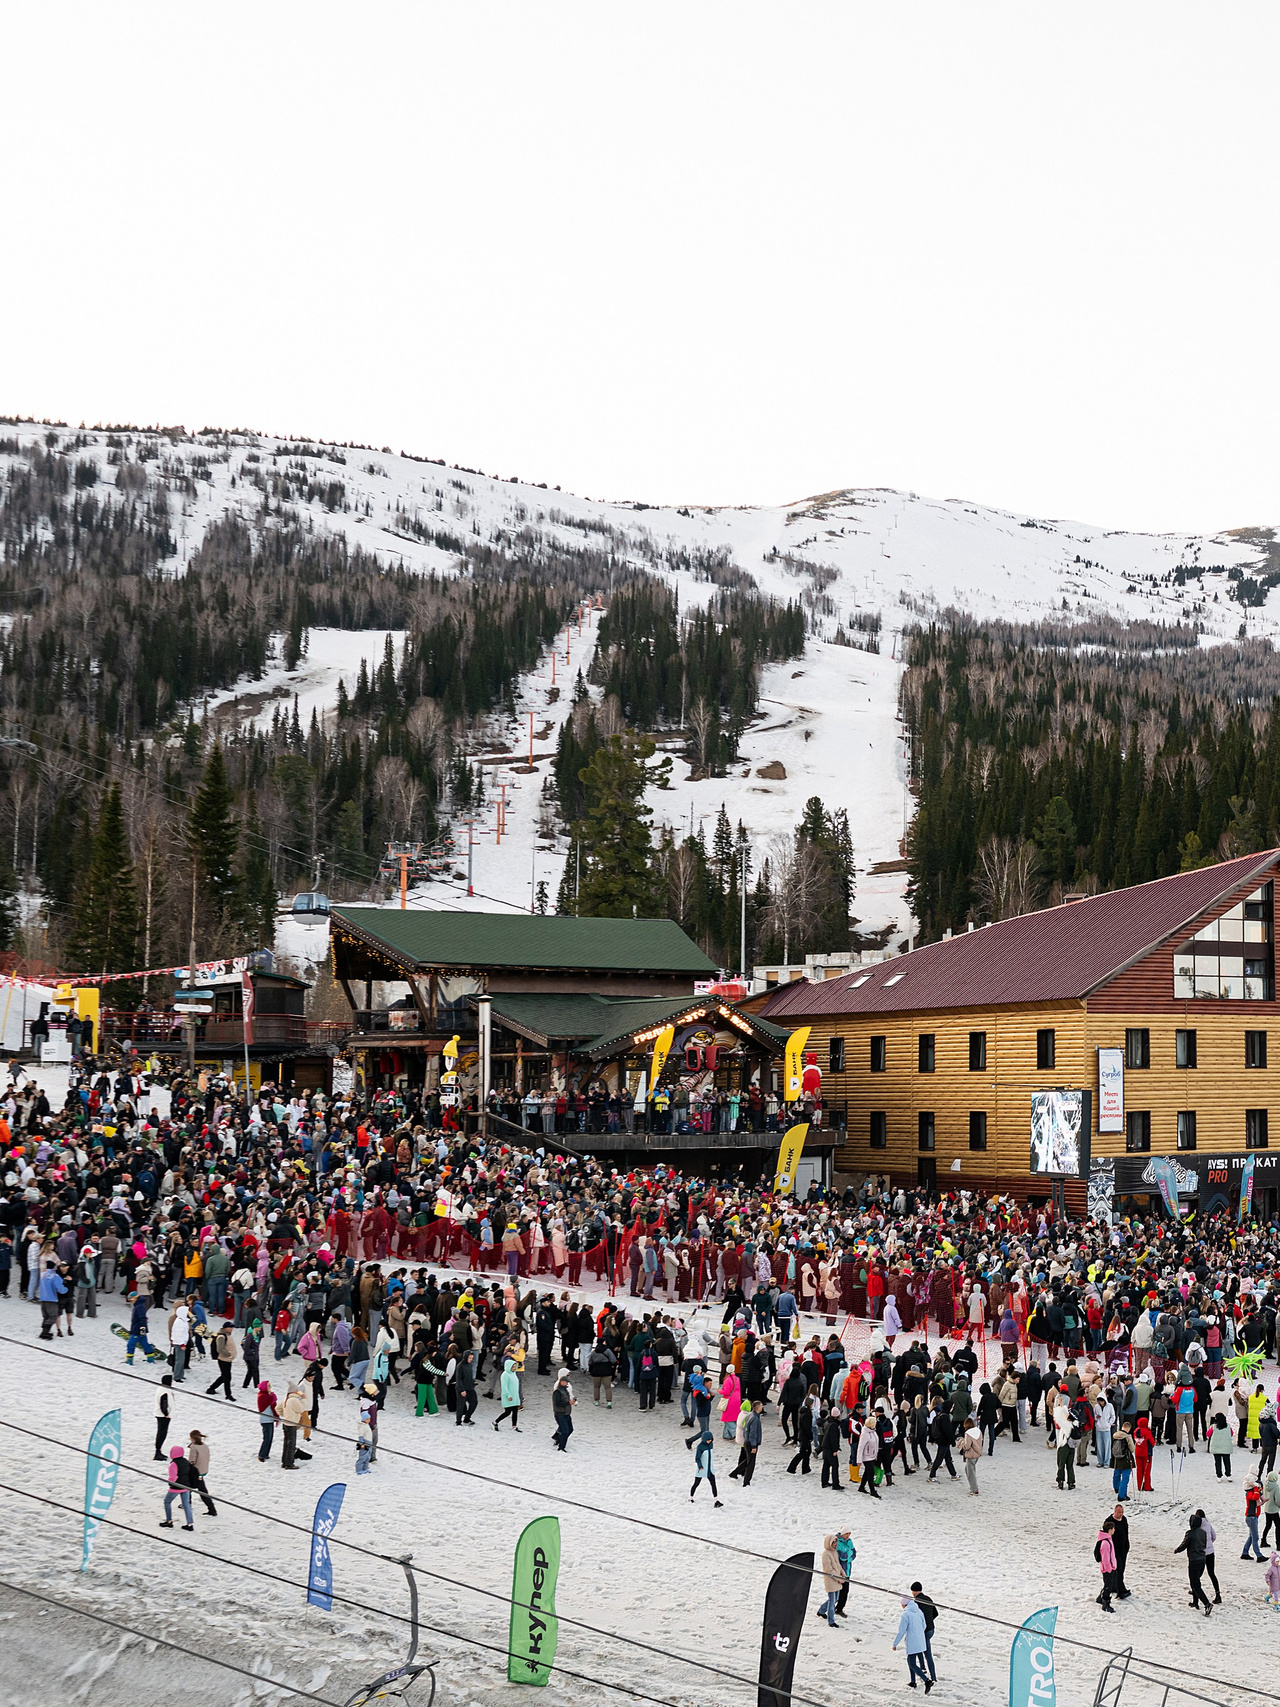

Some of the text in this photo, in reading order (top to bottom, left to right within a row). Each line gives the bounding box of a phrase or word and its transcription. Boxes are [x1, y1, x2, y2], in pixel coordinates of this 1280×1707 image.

[784, 1148, 795, 1173] БАНК
[1232, 1157, 1278, 1169] ПРКАТ
[1208, 1170, 1228, 1184] PRO
[529, 1547, 549, 1655] купер
[773, 1632, 790, 1653] t2
